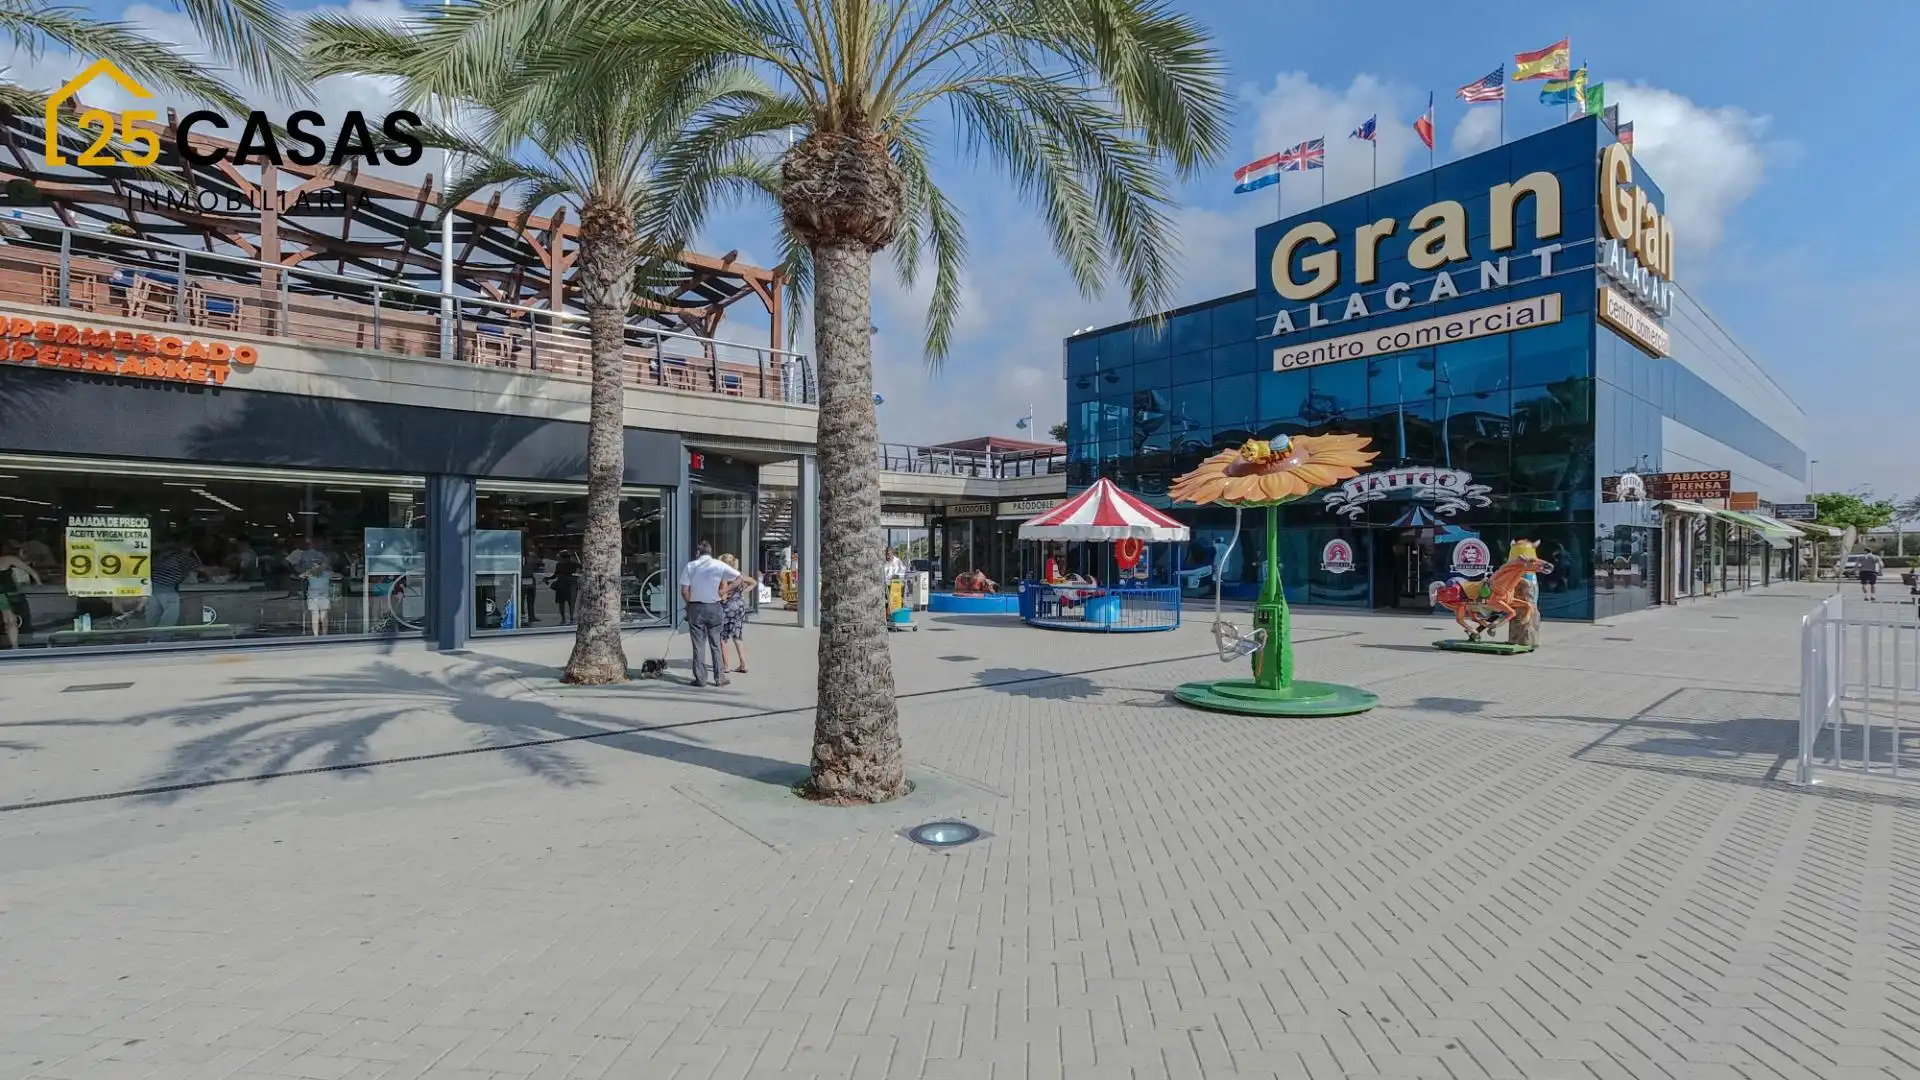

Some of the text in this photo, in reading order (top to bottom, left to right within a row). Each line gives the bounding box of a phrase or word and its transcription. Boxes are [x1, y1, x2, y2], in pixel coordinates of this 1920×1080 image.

[1601, 142, 1673, 282] Gran
[1271, 171, 1561, 300] Gran
[1272, 243, 1561, 335] ALACANT
[1609, 239, 1674, 317] ALACANT
[1608, 297, 1634, 330] centro
[1281, 299, 1546, 368] centro comercial
[1353, 472, 1458, 492] TATTOO
[1666, 471, 1728, 481] TABACOS
[1671, 481, 1722, 490] PRENSA
[1013, 500, 1054, 511] PASODOBLE
[68, 516, 149, 528] BAJADA DE PRECIO
[70, 530, 149, 539] ACEITE VIRGEN EXTRA
